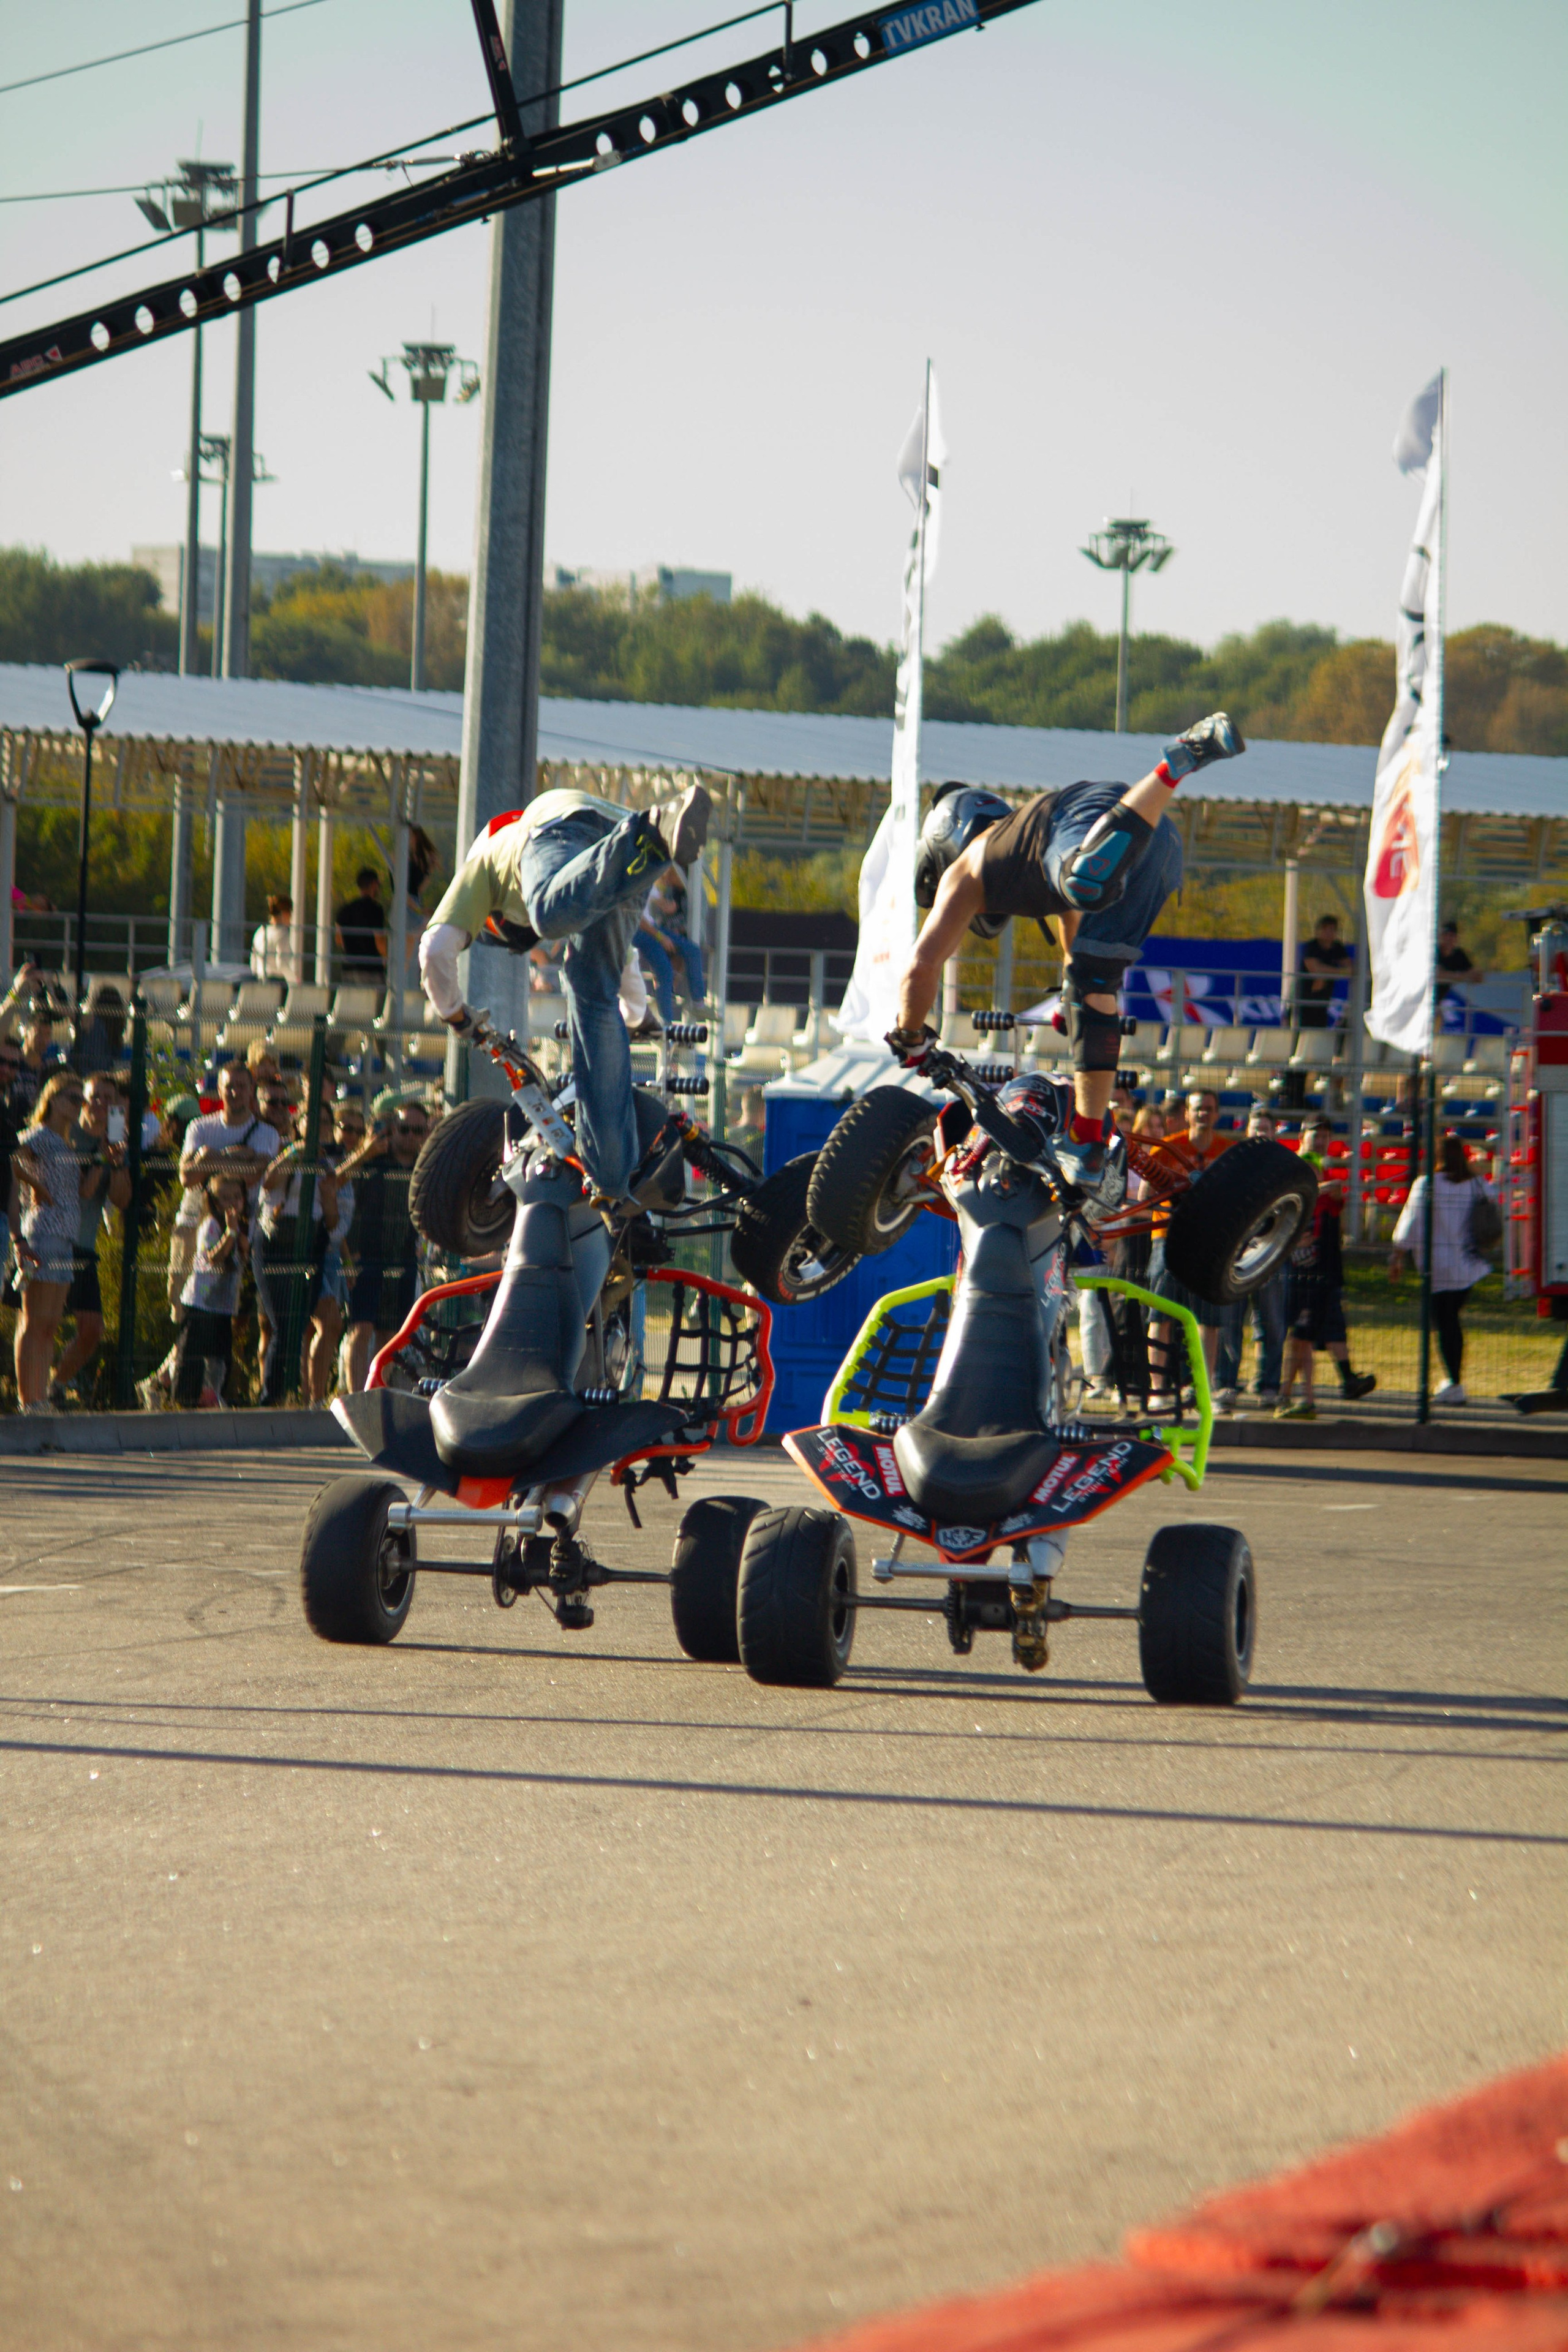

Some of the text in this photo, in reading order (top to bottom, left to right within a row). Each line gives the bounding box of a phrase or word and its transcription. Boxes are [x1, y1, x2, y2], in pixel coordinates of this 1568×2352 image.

[816, 1428, 881, 1500] LEGEND
[818, 1446, 858, 1491] STUNT TEAM
[875, 1447, 903, 1494] MOTUL
[1033, 1455, 1078, 1502] MOTUL
[1050, 1442, 1133, 1513] LEGEND
[1103, 1457, 1130, 1477] TEAM
